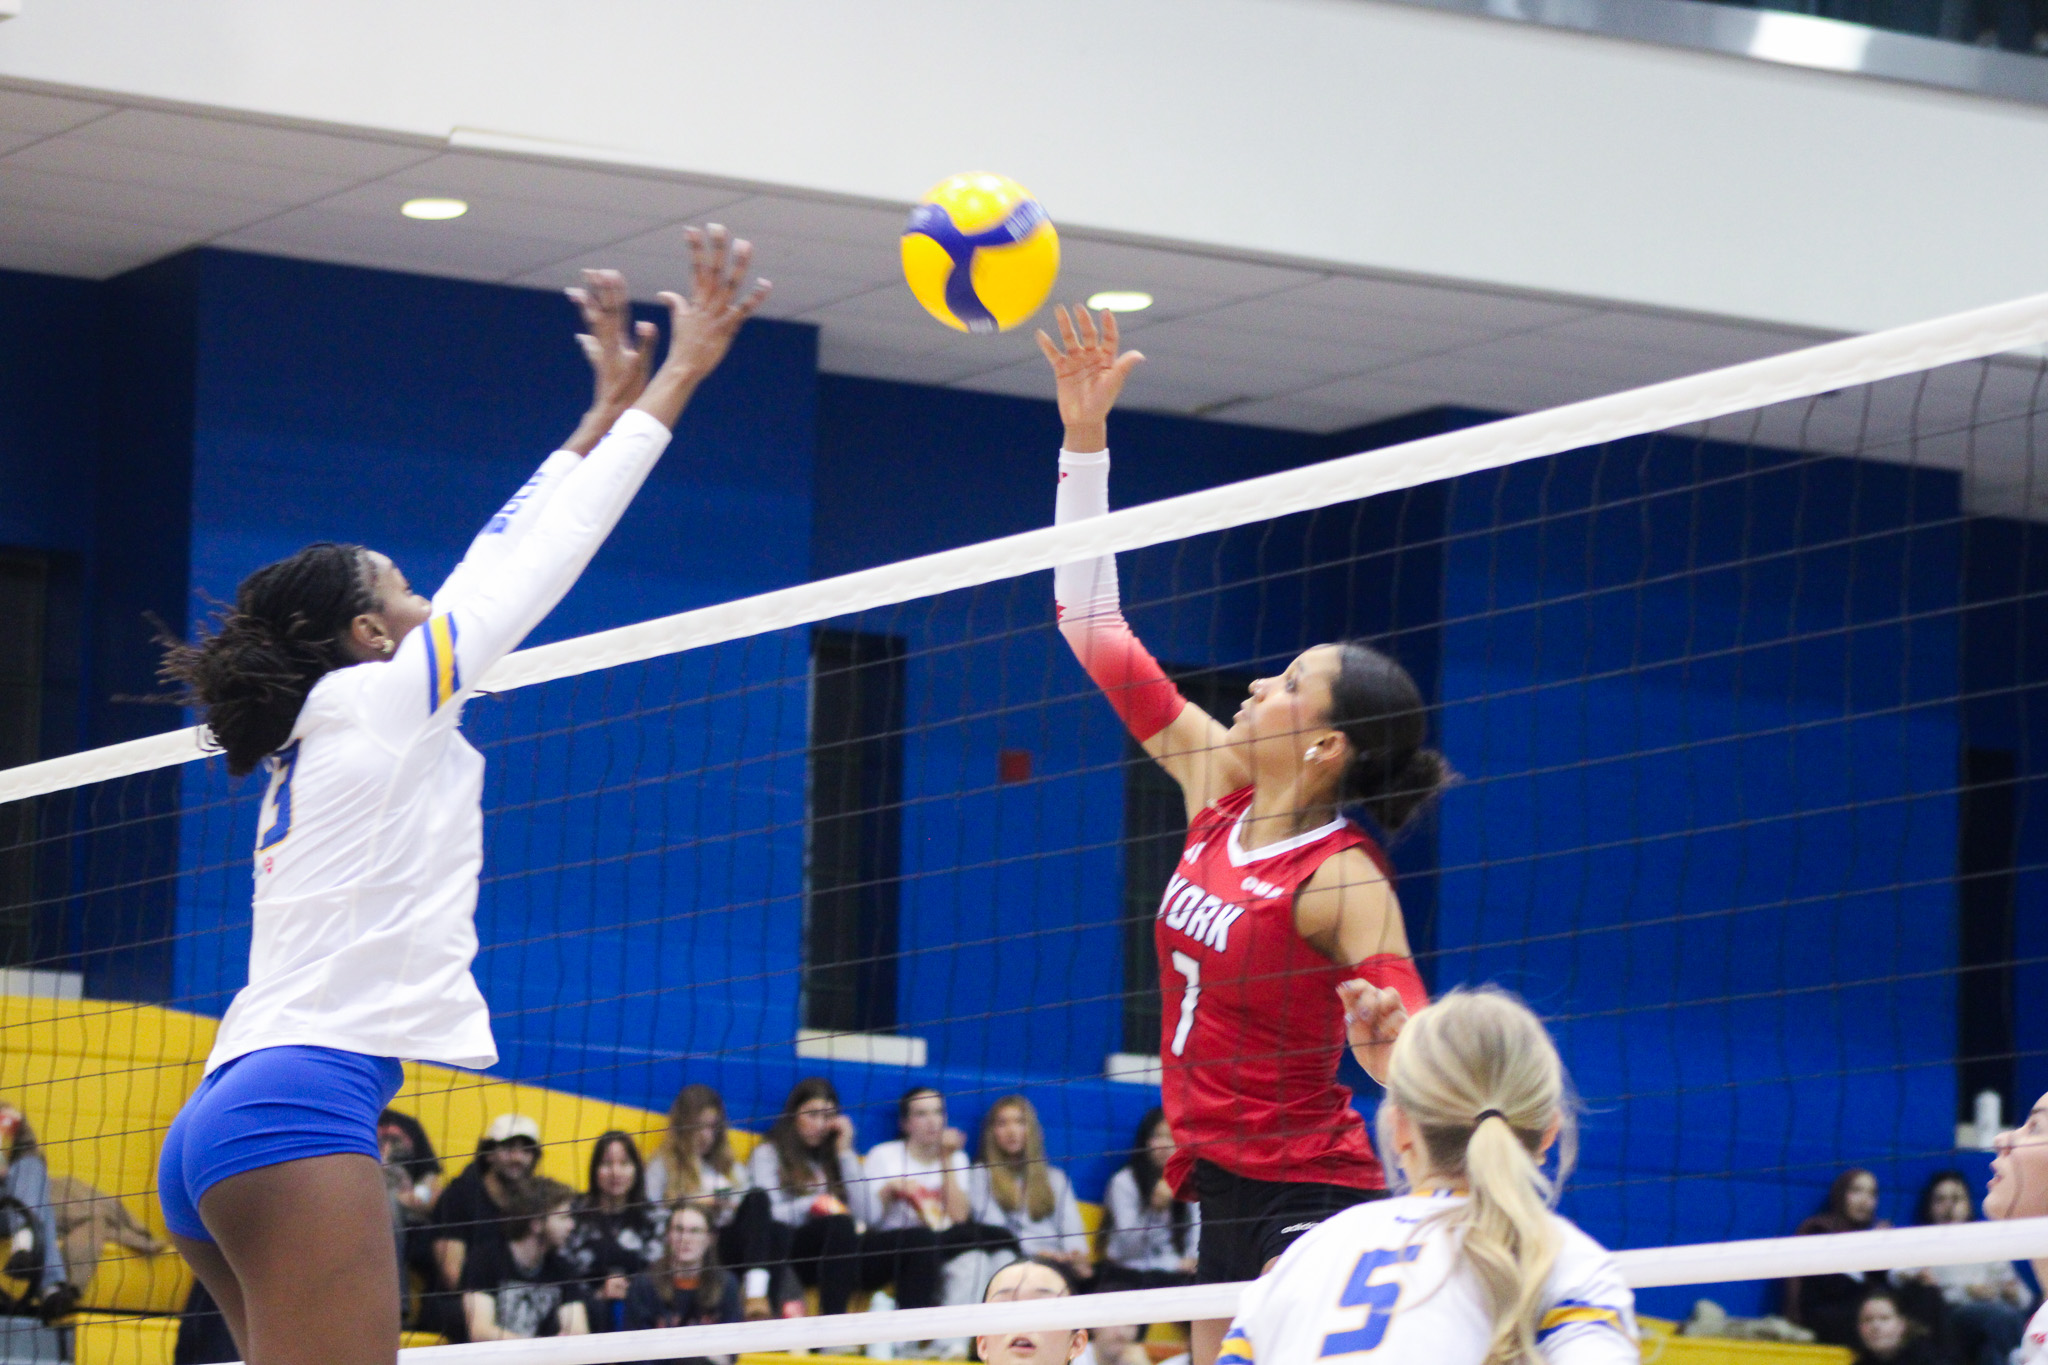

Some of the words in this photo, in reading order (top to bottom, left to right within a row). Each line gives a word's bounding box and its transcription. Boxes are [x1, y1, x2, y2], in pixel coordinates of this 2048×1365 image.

[1158, 872, 1245, 953] YORK
[1172, 951, 1200, 1057] 7
[1318, 1244, 1426, 1360] 5
